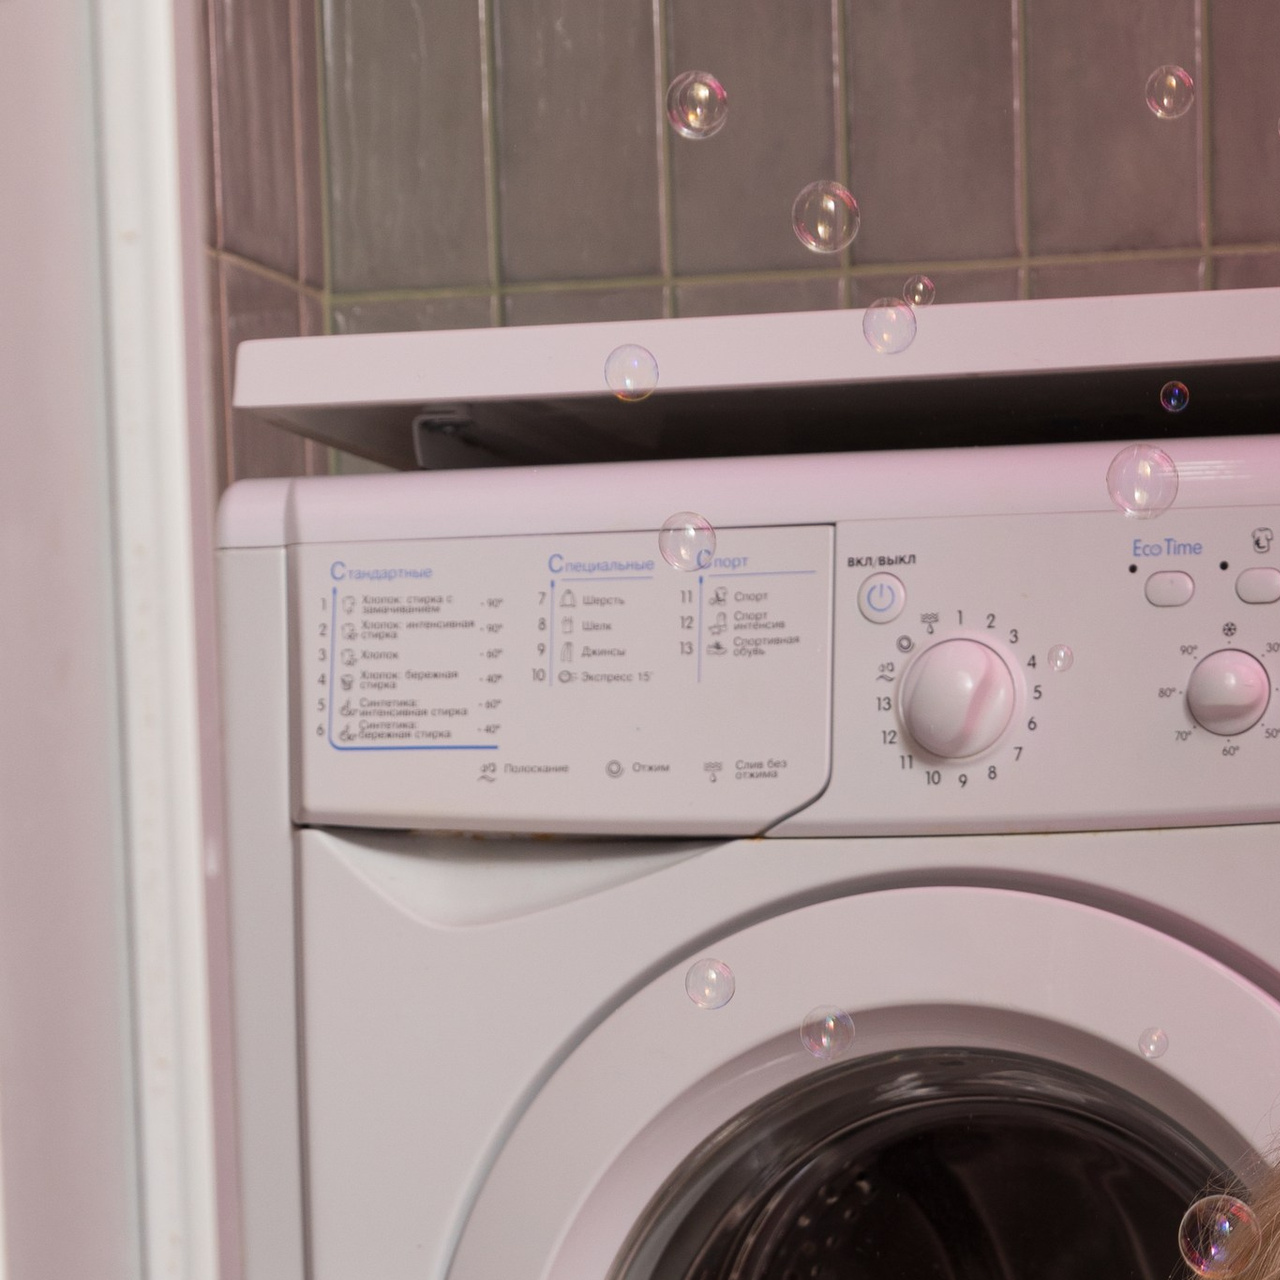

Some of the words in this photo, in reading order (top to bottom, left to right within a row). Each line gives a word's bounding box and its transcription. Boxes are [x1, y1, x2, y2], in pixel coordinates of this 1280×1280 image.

[548, 553, 655, 575] Специальные
[697, 549, 748, 570] Спорт
[847, 554, 916, 568] ВКЛ/ВЫКЛ
[330, 561, 433, 580] Стандартные
[538, 591, 547, 605] 7
[582, 595, 625, 607] Шерсть
[680, 590, 693, 603] 11
[734, 592, 768, 602] Спорт
[679, 615, 694, 629] 12
[733, 611, 767, 622] Спорт
[986, 613, 996, 629] 2
[318, 624, 327, 637] 2
[537, 617, 547, 631] 8
[1009, 629, 1019, 644] 3
[318, 648, 327, 661] 3
[537, 642, 546, 656] 9
[581, 646, 626, 658] Джинсы
[679, 641, 694, 655] 13
[1027, 655, 1037, 669] 4
[317, 673, 326, 685] 4
[532, 668, 546, 681] 10
[581, 671, 633, 682] Экспресс
[1033, 685, 1042, 700] 5
[317, 698, 326, 711] 5
[876, 697, 891, 712] 13
[316, 724, 325, 737] 6
[1028, 716, 1037, 731] 6
[881, 730, 897, 745] 12
[1013, 747, 1023, 761] 7
[504, 763, 569, 775] Полоскание
[632, 762, 670, 773] Отжим
[735, 760, 763, 770] Слив
[767, 758, 787, 770] без
[900, 755, 914, 769] 11
[926, 770, 941, 785] 10
[988, 766, 997, 780] 8
[958, 774, 968, 788] 9
